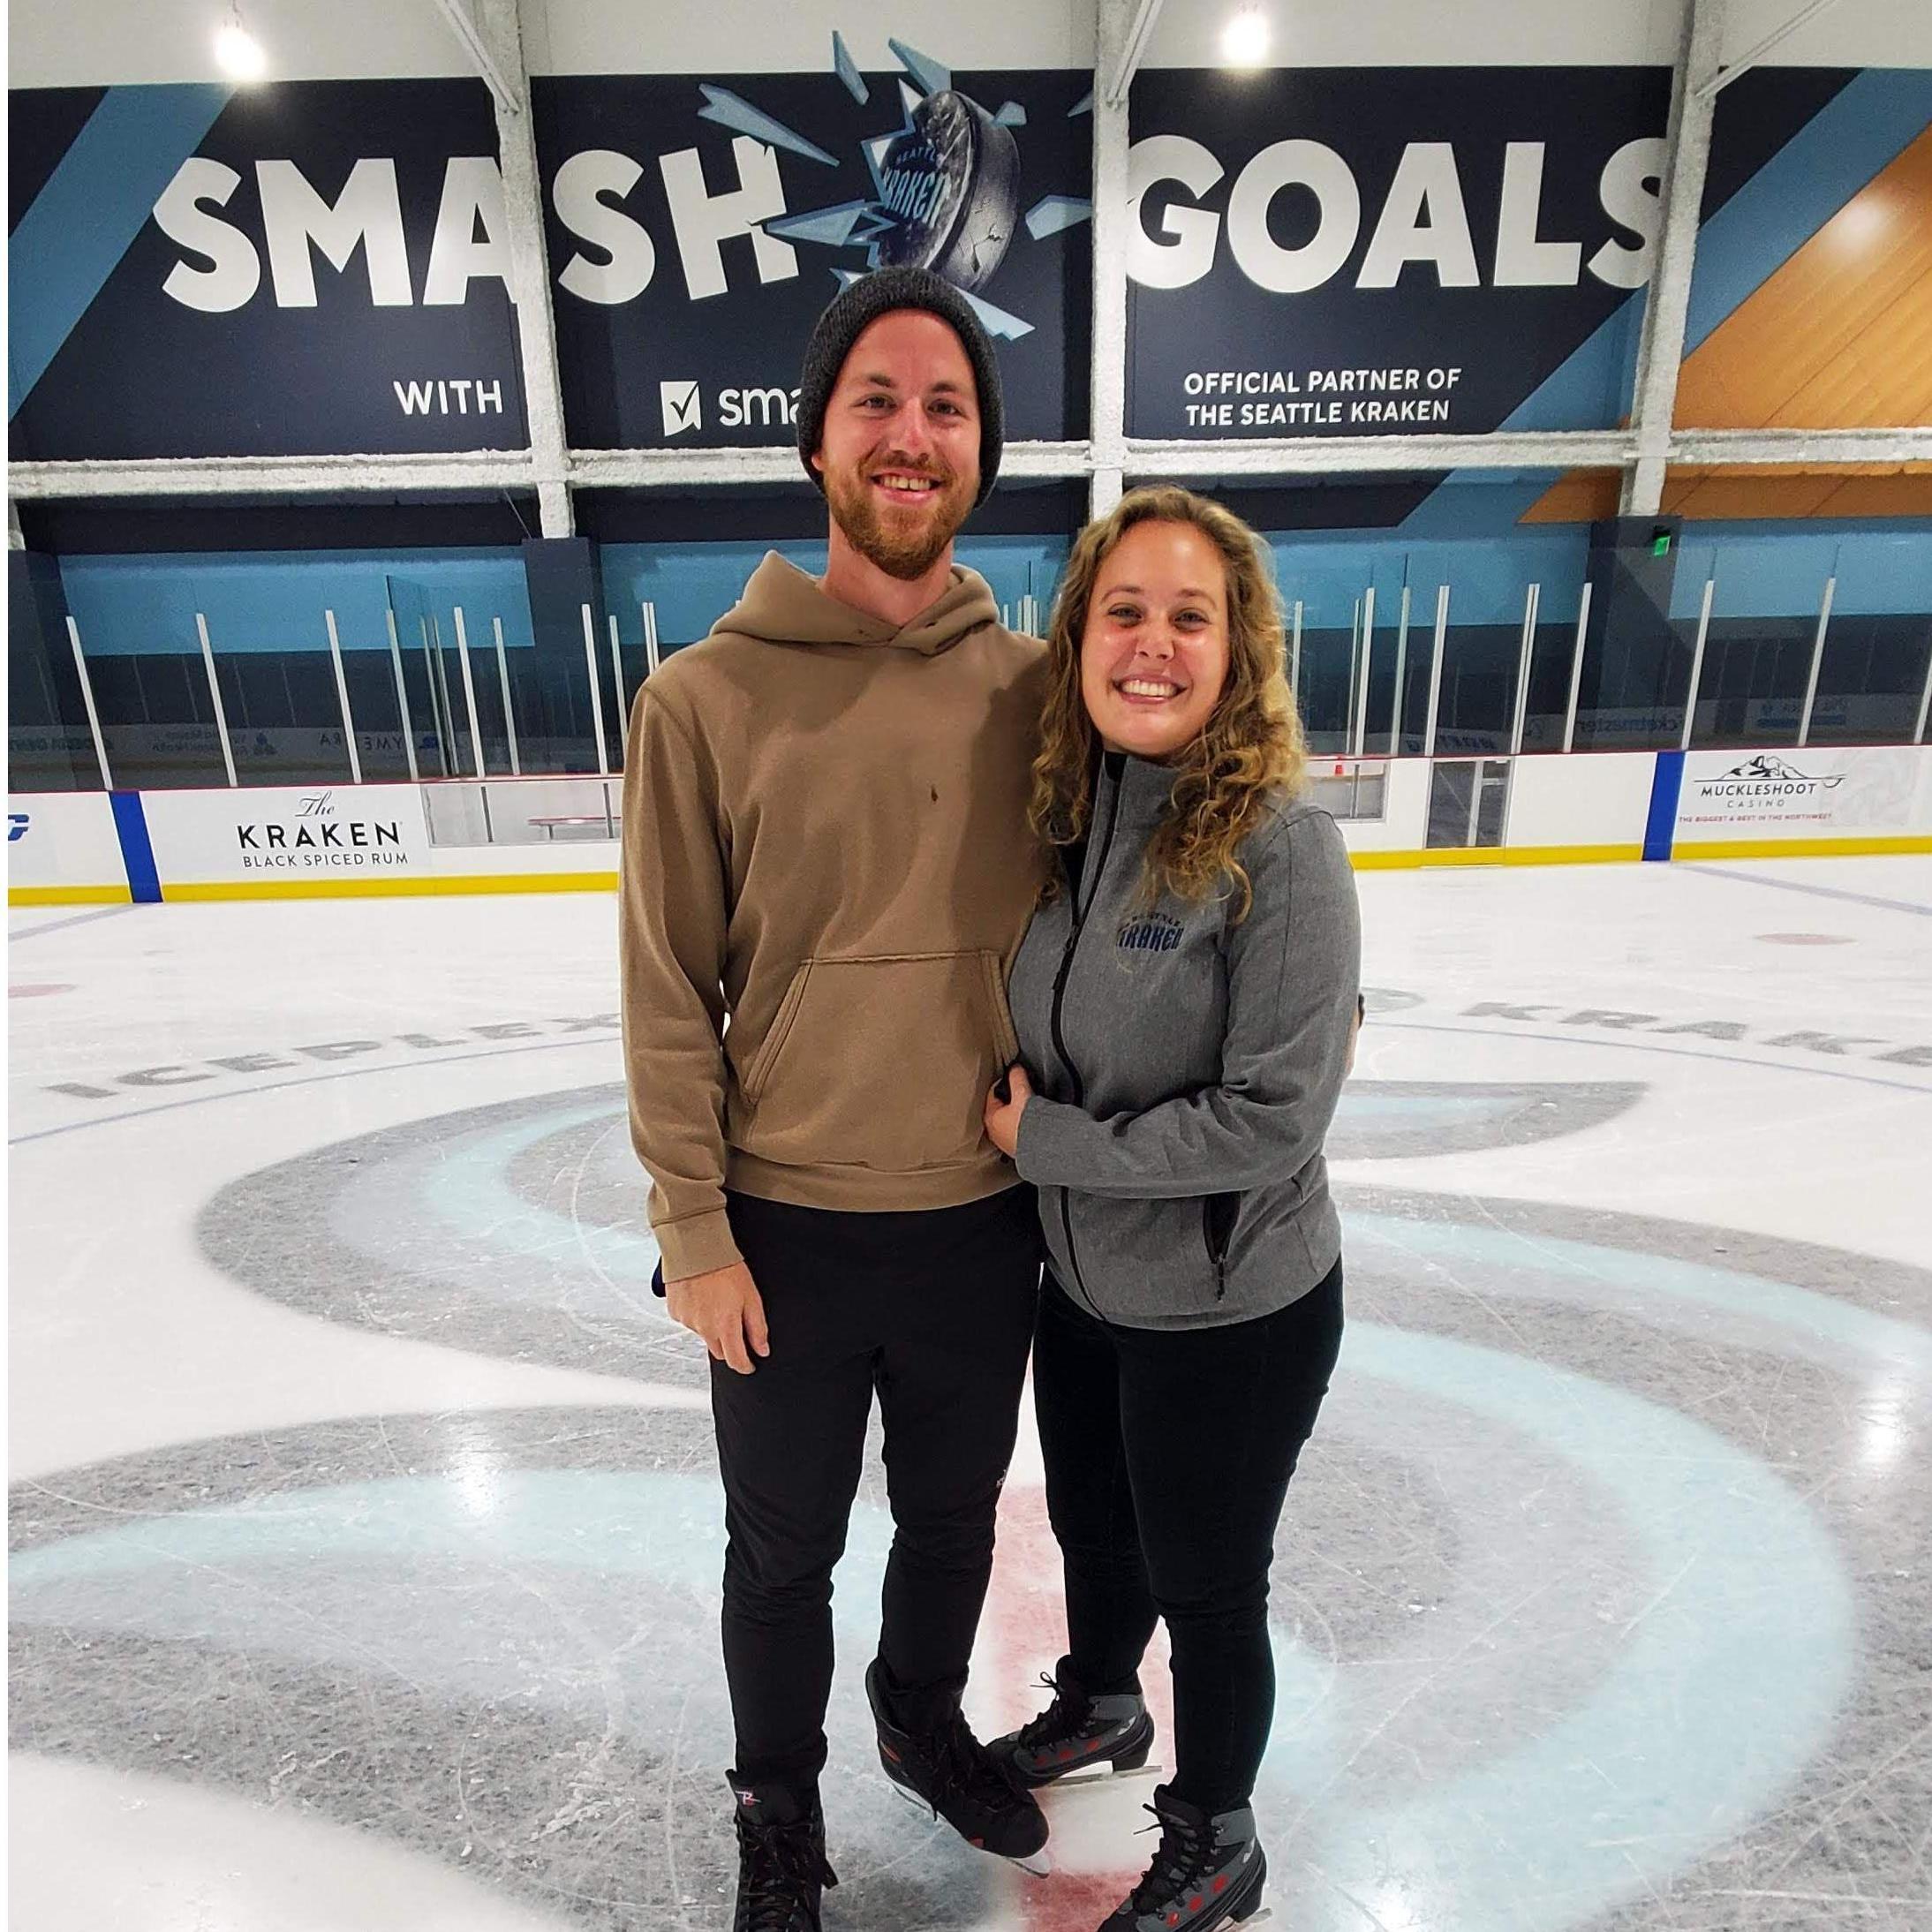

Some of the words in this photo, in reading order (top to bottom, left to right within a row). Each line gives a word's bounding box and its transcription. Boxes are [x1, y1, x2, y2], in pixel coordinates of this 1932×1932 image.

[895, 144, 943, 165] SEATTL
[883, 166, 952, 229] KRAKEN
[152, 135, 799, 313] SMASH
[1126, 134, 1665, 293] GOALS
[1184, 371, 1300, 395] OFFICIAL
[1309, 369, 1419, 392] PARTNER
[1427, 367, 1462, 390] OF
[394, 380, 503, 415] WITH
[1186, 404, 1234, 426] THE
[1241, 402, 1342, 425] SEATTLE
[1351, 400, 1449, 423] KRAKEN
[295, 790, 335, 817] The
[1701, 783, 1816, 797] MUCKLESHOOT
[1727, 798, 1785, 809] CASINO
[237, 822, 400, 849] KRAKEN
[243, 854, 298, 868] BLACK
[304, 853, 364, 866] SPICED
[372, 852, 408, 864] RUM
[41, 1013, 623, 1098] ICEPLEX
